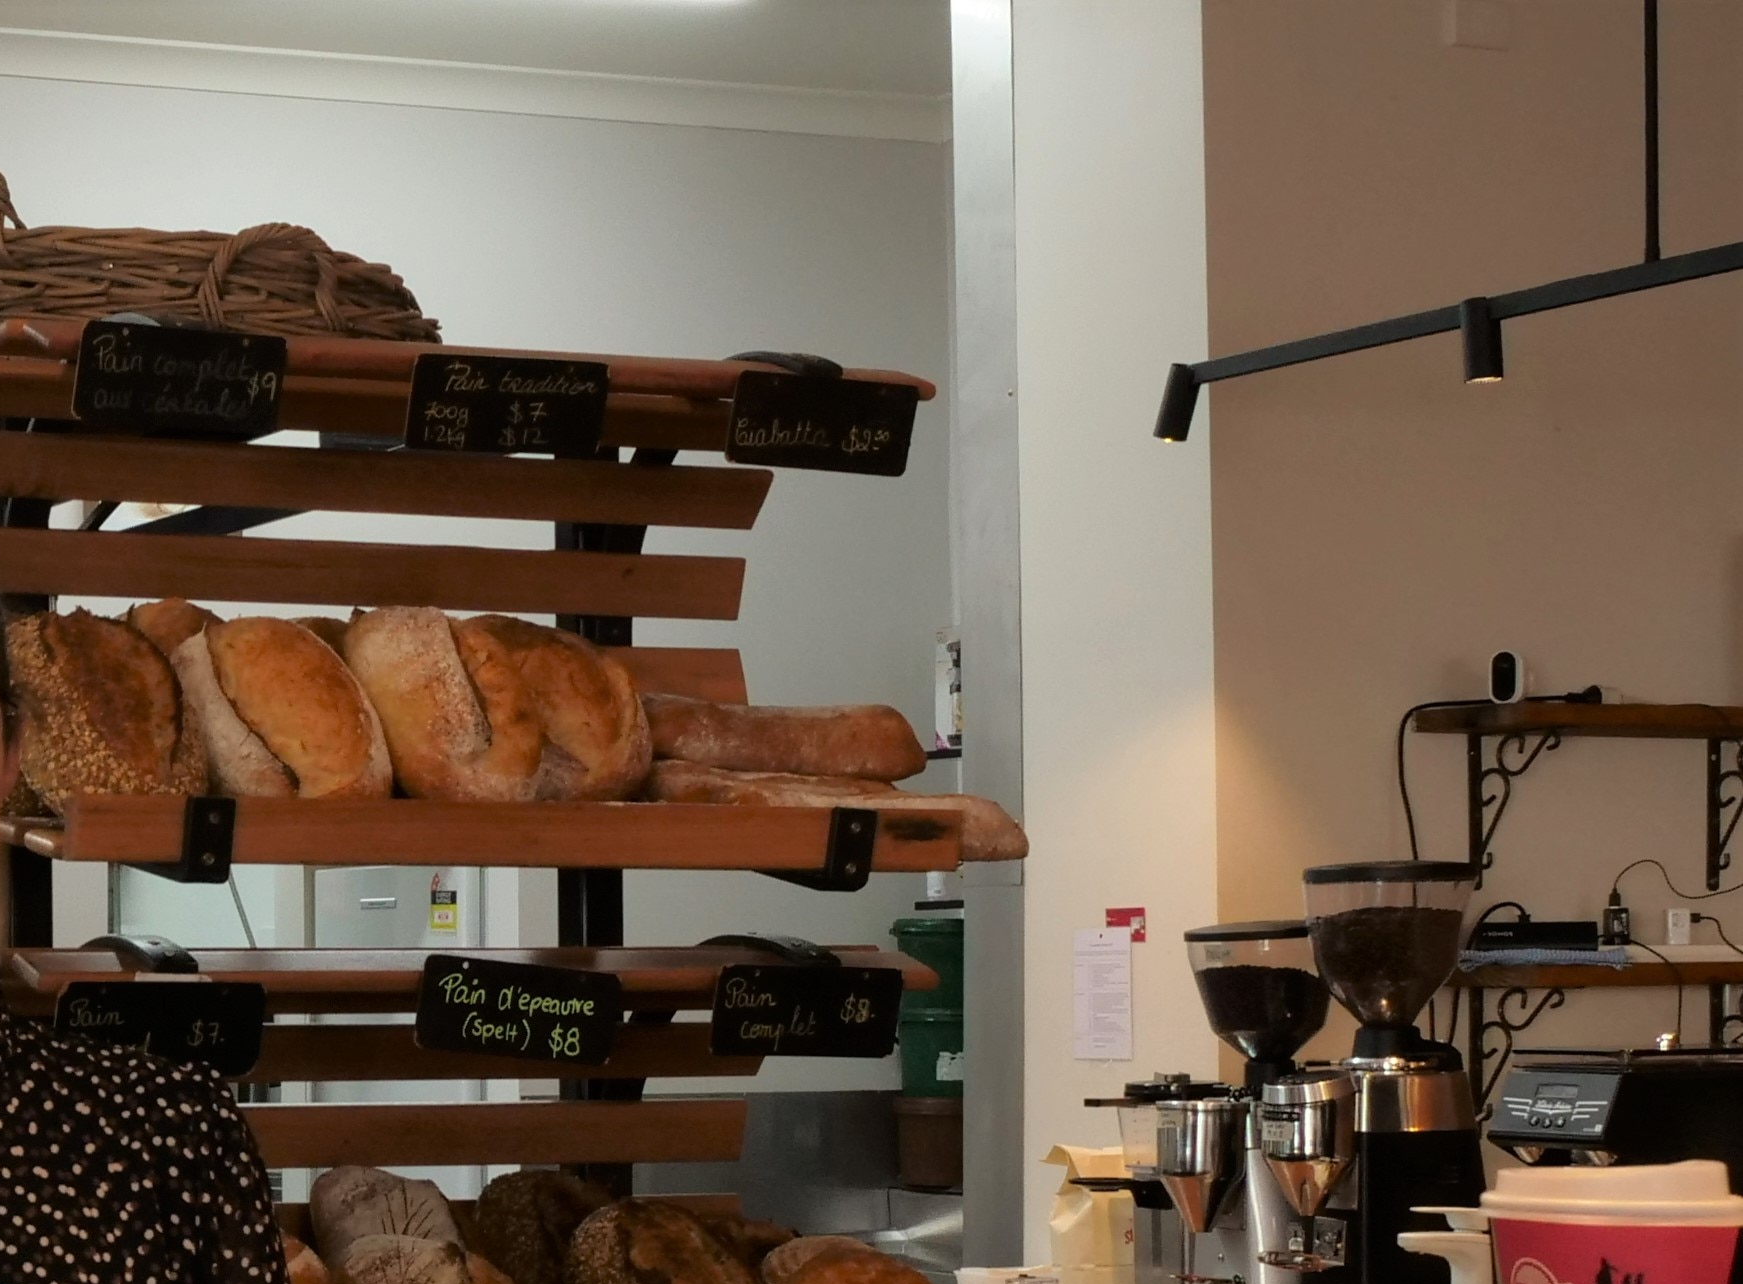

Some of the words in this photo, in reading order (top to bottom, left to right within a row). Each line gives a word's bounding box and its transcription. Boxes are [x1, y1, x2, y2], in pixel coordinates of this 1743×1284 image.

[93, 334, 143, 373] Pain
[153, 349, 249, 393] complet
[444, 361, 489, 392] Pain
[498, 366, 599, 395] tradition
[247, 371, 277, 406] $9
[424, 400, 469, 428] 700g
[736, 417, 833, 448] Ciabatta
[438, 972, 486, 1005] Pain
[724, 976, 777, 1010] Pain
[69, 997, 125, 1027] Pain
[739, 1003, 817, 1052] complet
[547, 1022, 581, 1059] $8
